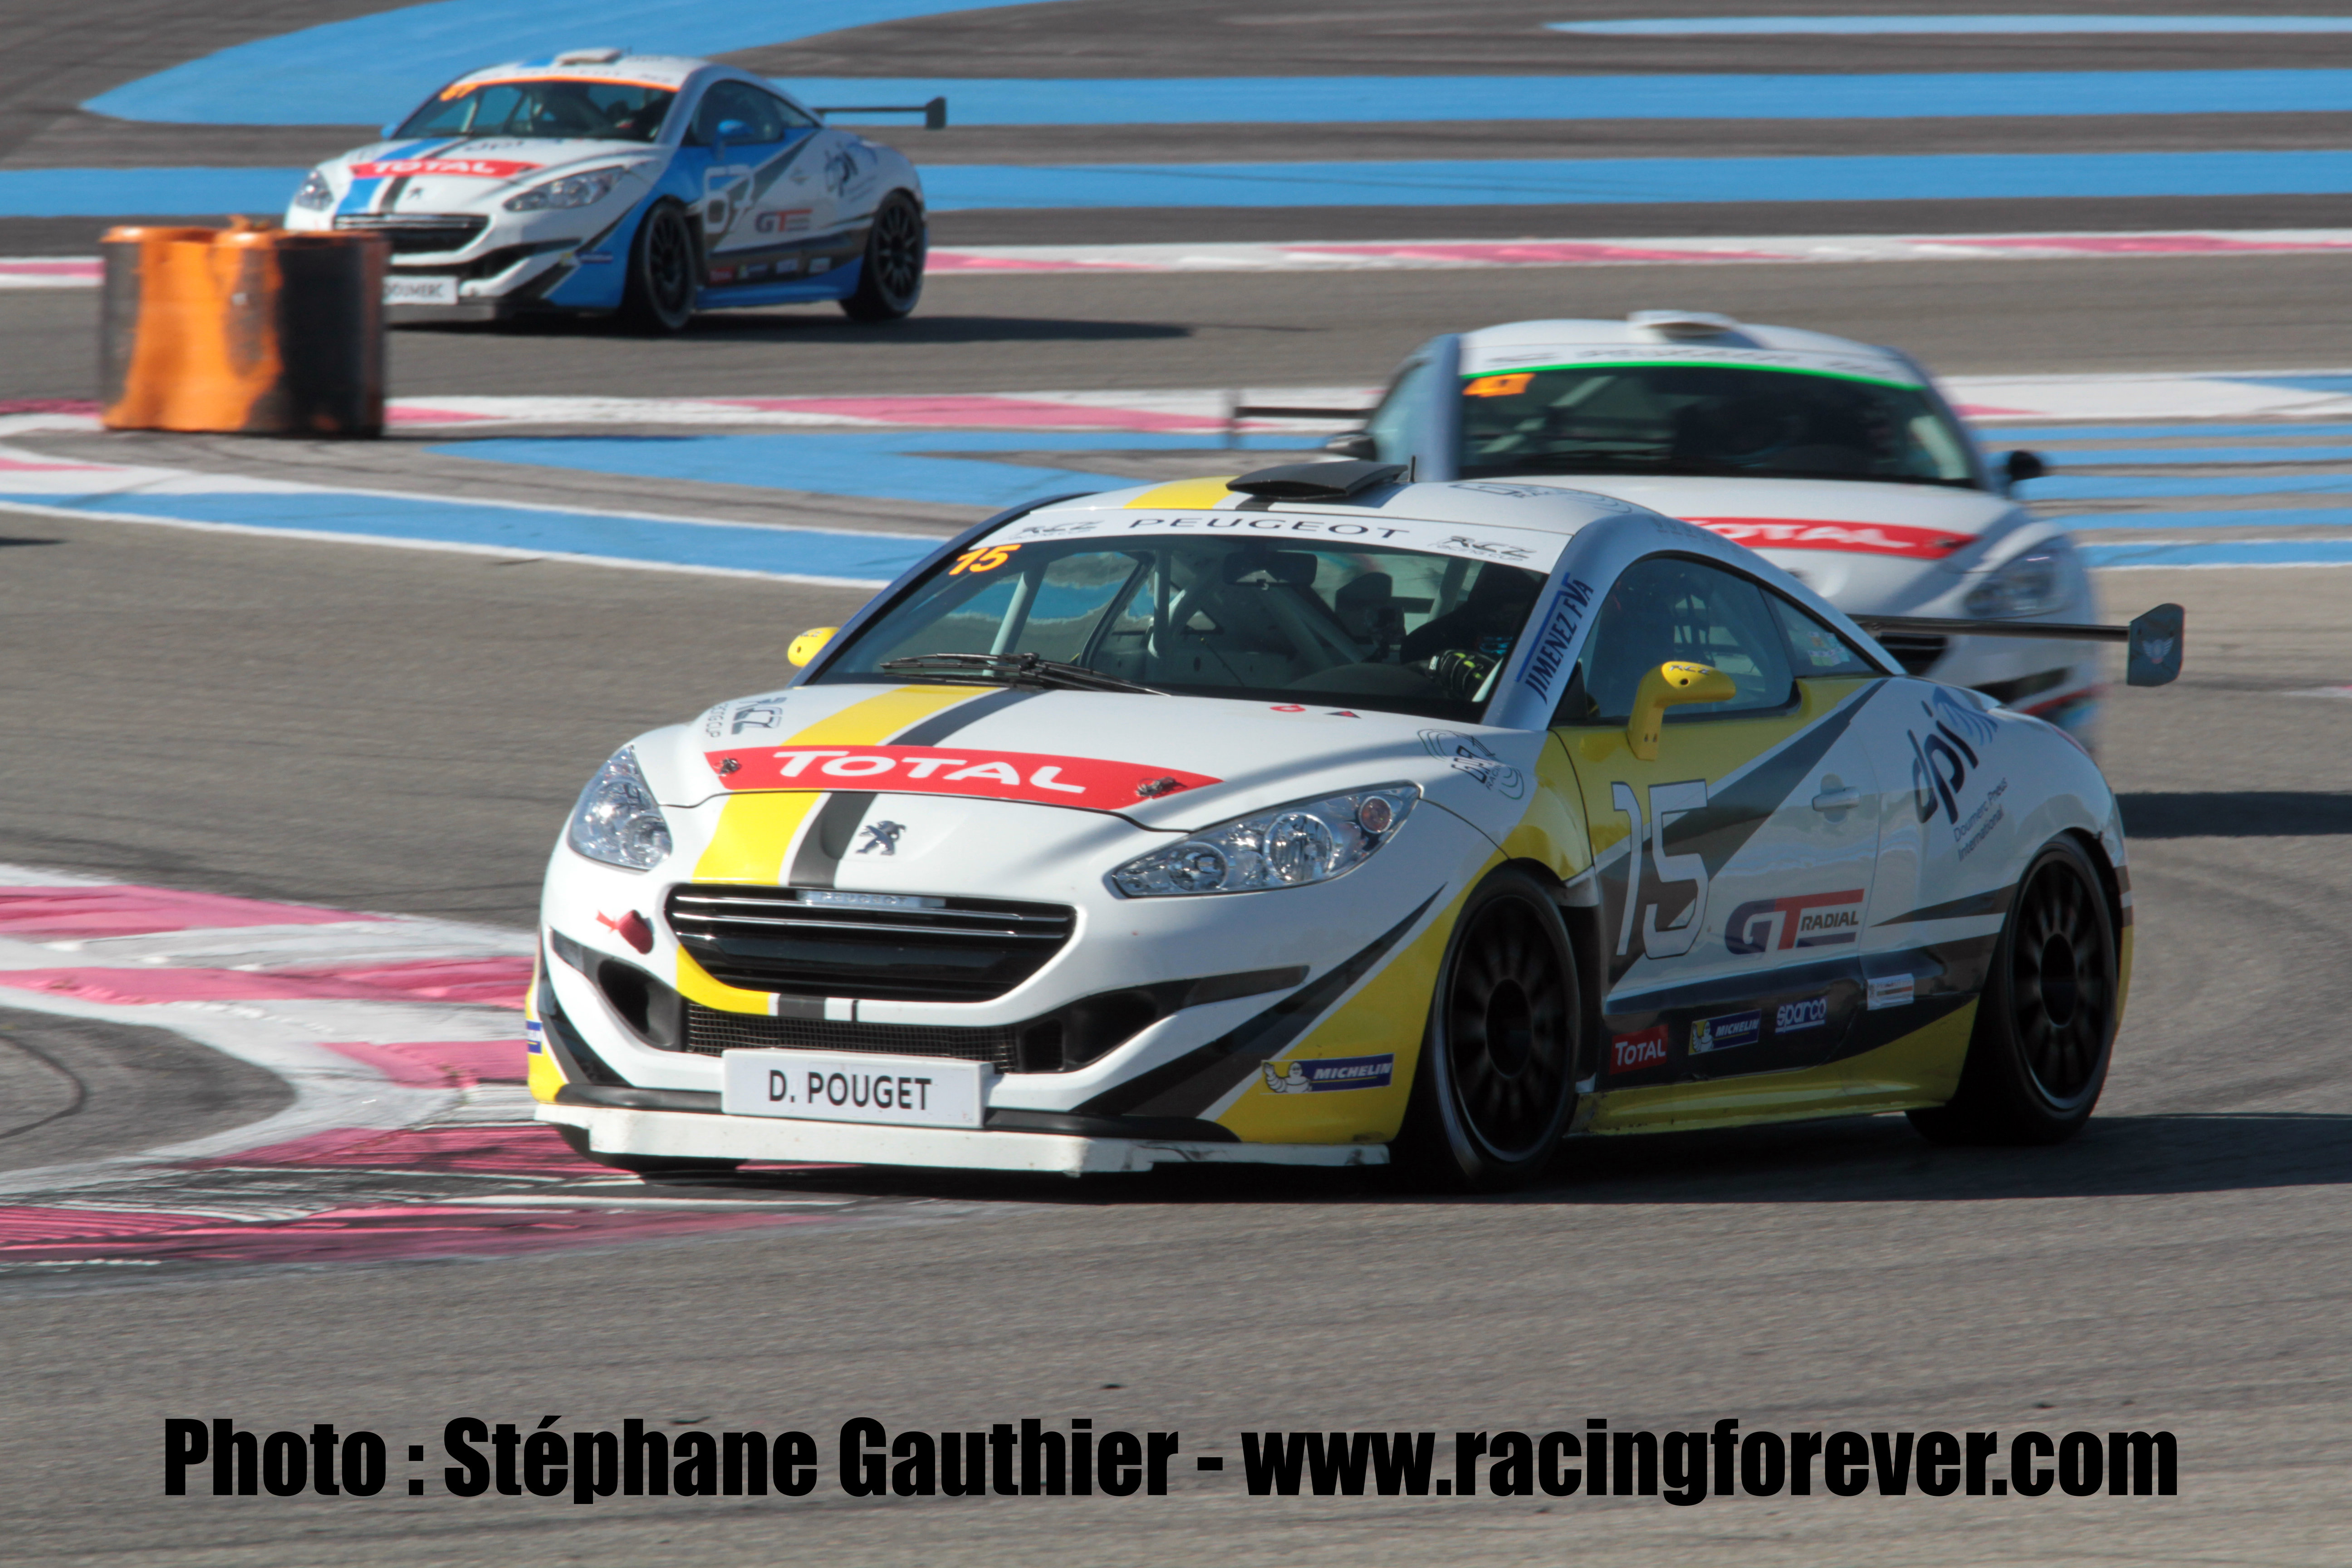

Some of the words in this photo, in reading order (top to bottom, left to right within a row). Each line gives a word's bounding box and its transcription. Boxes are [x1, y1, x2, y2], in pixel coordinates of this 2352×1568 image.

[374, 161, 496, 174] TOTAL
[1129, 518, 1410, 539] PEUGEOT
[1689, 520, 1916, 548] OTAL
[949, 544, 1021, 575] 15
[1525, 612, 1578, 705] JIMENEZ
[1669, 665, 1710, 675] RCZ
[773, 750, 1087, 794] TOTAL
[1958, 804, 2005, 862] International
[1611, 779, 1710, 960] 15
[1725, 888, 1865, 955] GT
[1800, 911, 1859, 931] RADIAL
[1715, 1018, 1760, 1037] MICHELIN
[1776, 998, 1827, 1030] sparco
[1615, 1039, 1667, 1066] TOTAL
[1313, 1063, 1393, 1079] MICHELIN
[769, 1069, 795, 1102] D.
[808, 1072, 932, 1110] POUGET
